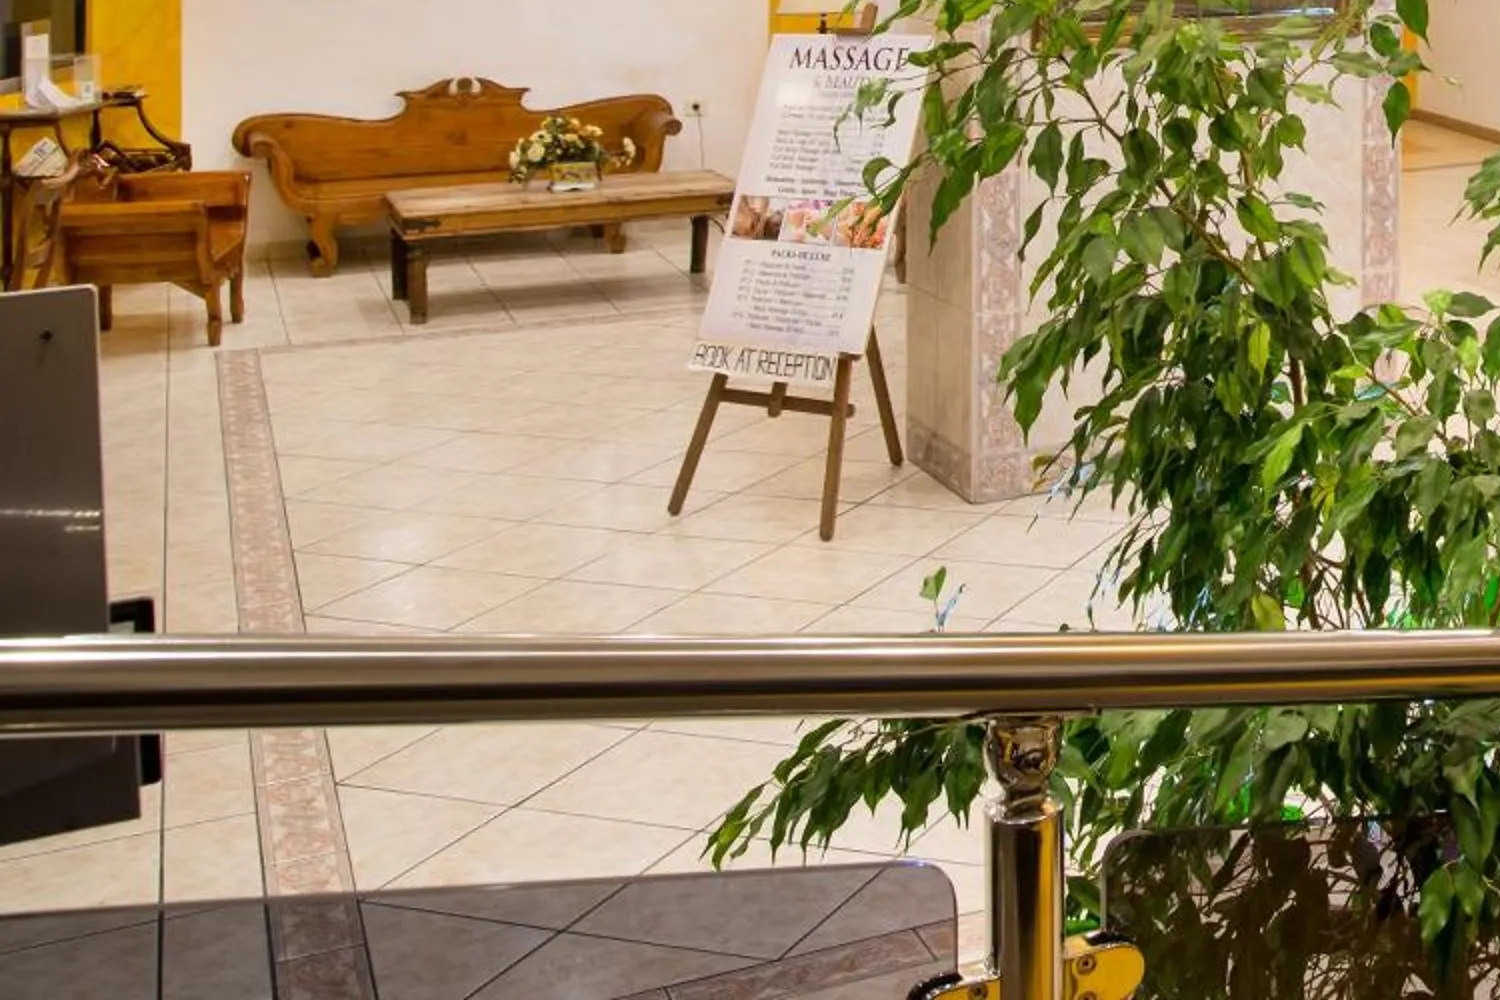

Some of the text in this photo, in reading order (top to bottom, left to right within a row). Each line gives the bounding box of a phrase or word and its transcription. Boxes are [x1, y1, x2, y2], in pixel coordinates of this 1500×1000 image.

[789, 46, 910, 71] MASSAGE
[694, 344, 836, 380] BOOK AT RECEPTION
